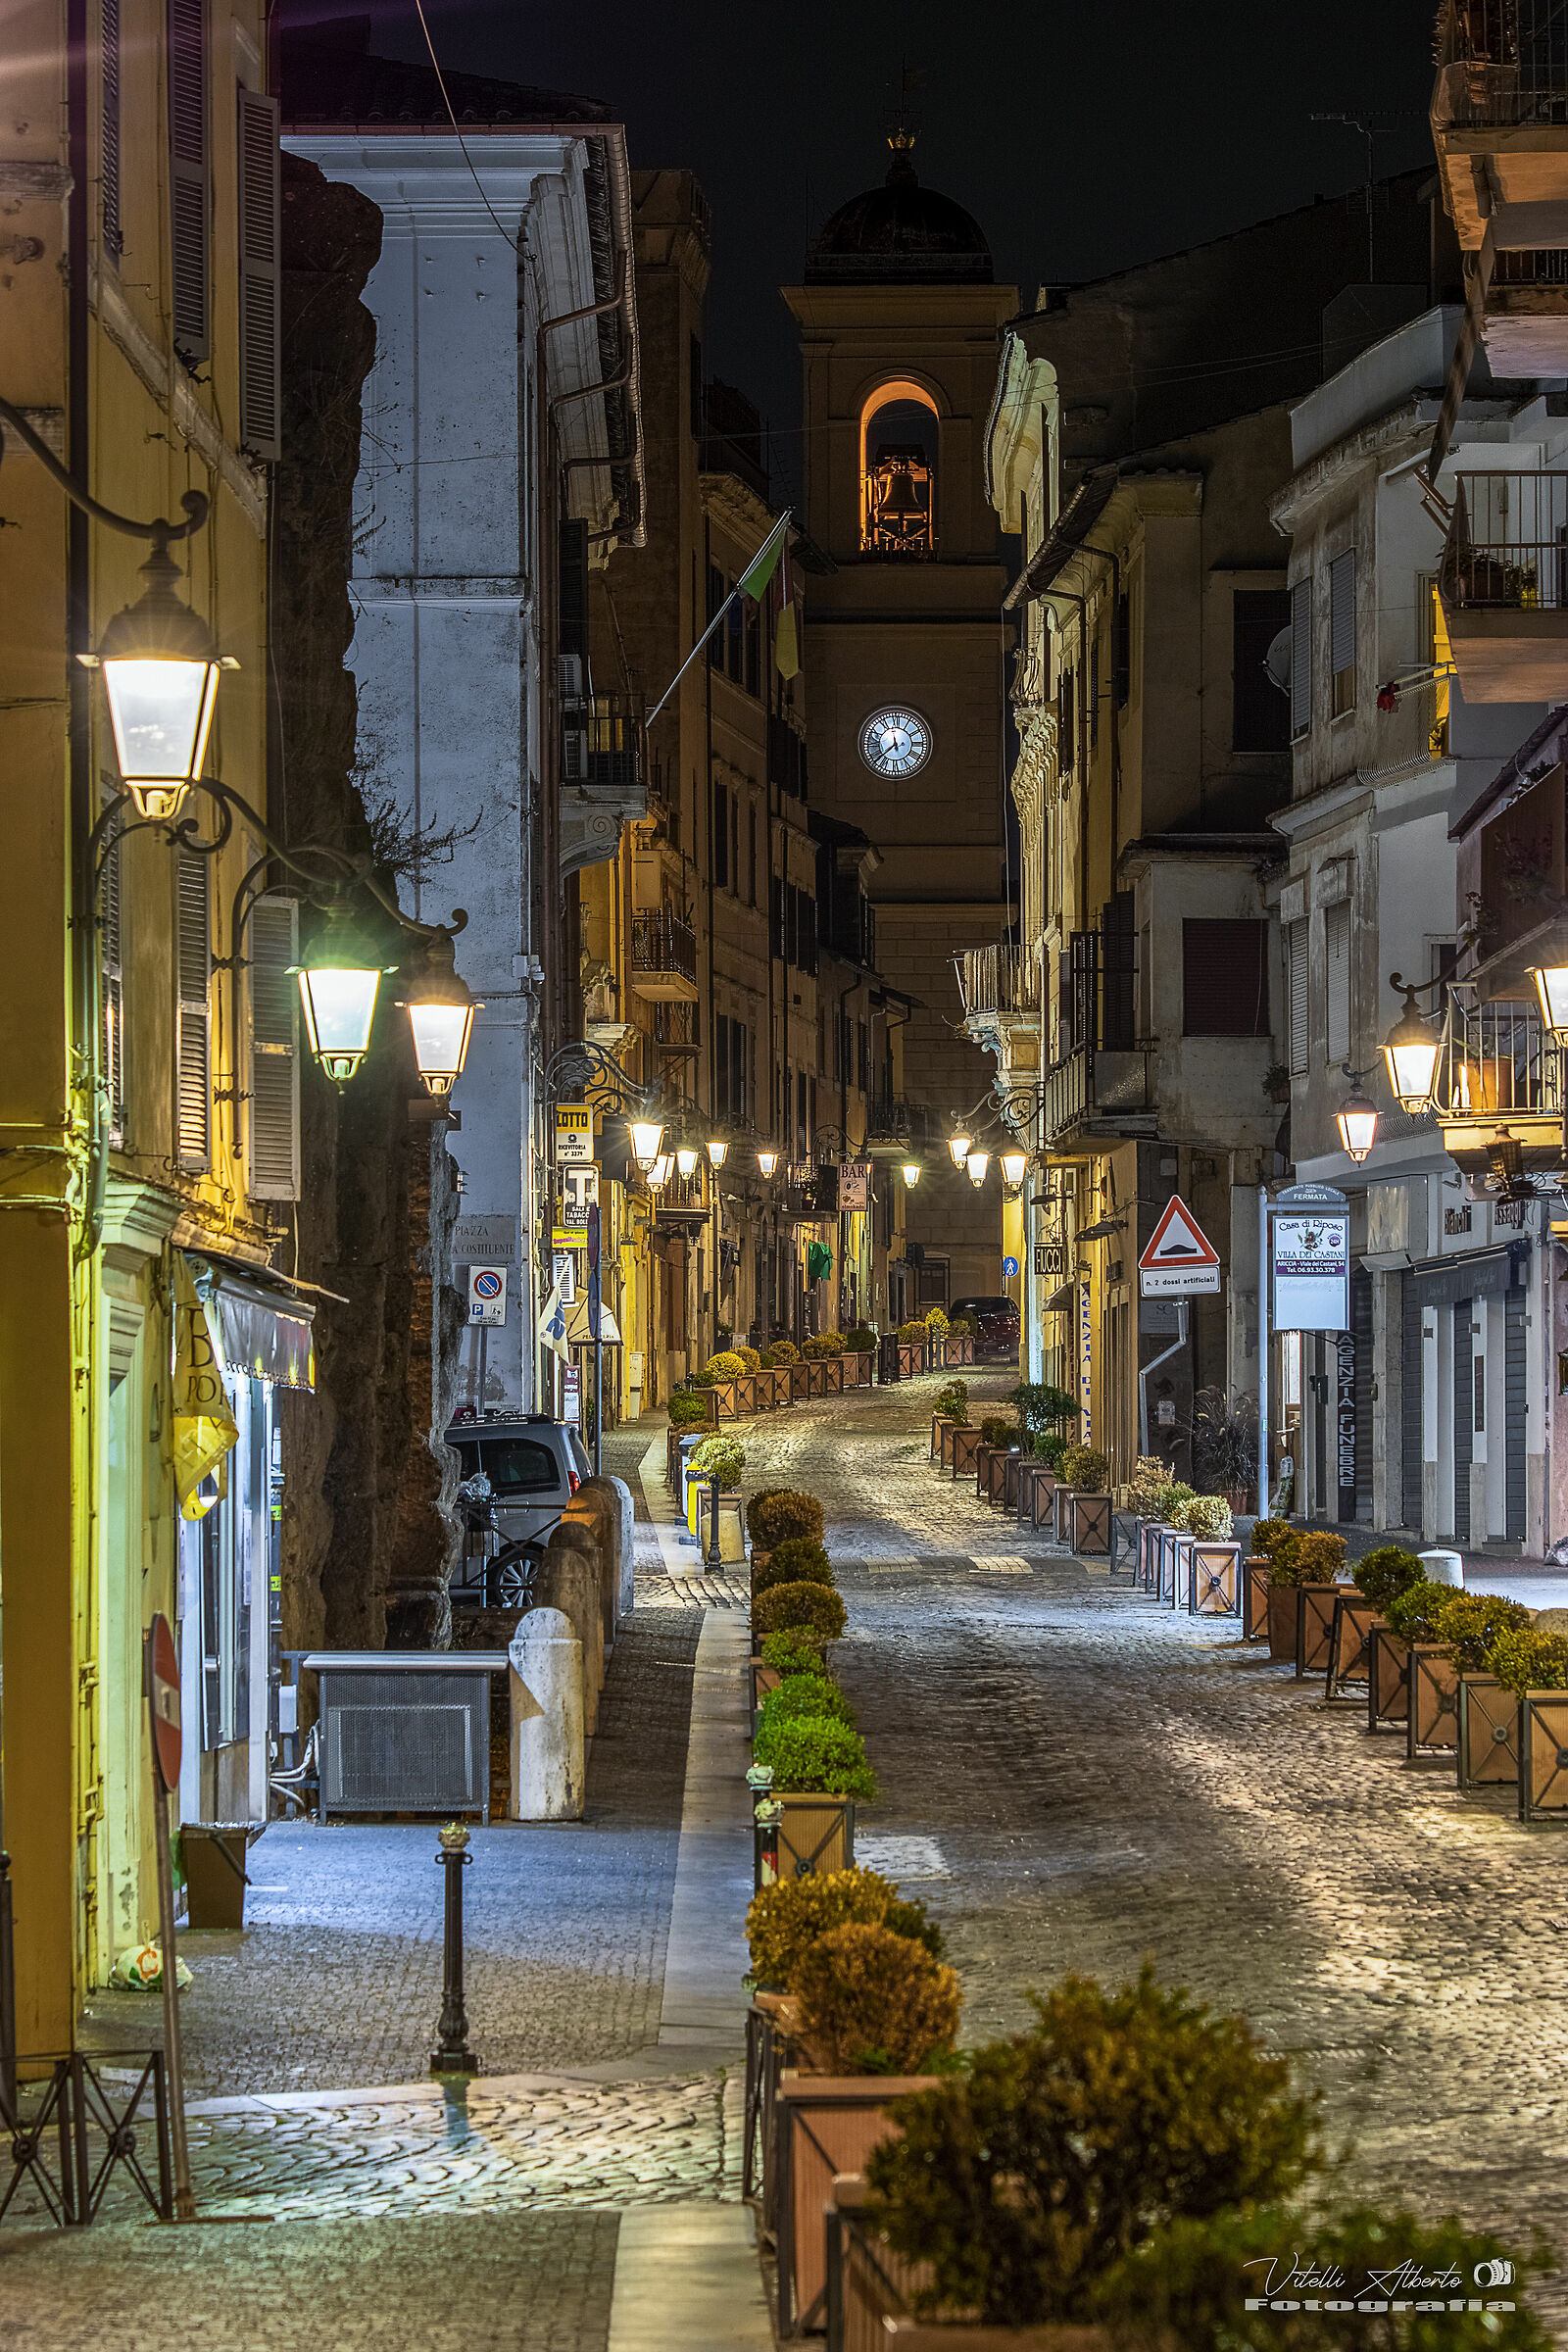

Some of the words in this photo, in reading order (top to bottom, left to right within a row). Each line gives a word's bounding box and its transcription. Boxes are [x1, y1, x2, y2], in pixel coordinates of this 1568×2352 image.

[557, 1111, 588, 1127] LOTTO
[840, 1164, 865, 1178] BAR
[455, 1225, 489, 1236] PIAZZA
[1279, 1222, 1299, 1231] Casa
[1312, 1219, 1344, 1232] Riposo
[461, 1244, 514, 1254] COSTITUENTE
[1162, 1277, 1181, 1286] dossi
[1183, 1276, 1215, 1285] artificiali
[1339, 1335, 1355, 1407] AGENZIA
[1339, 1414, 1355, 1487] FUNEBRE
